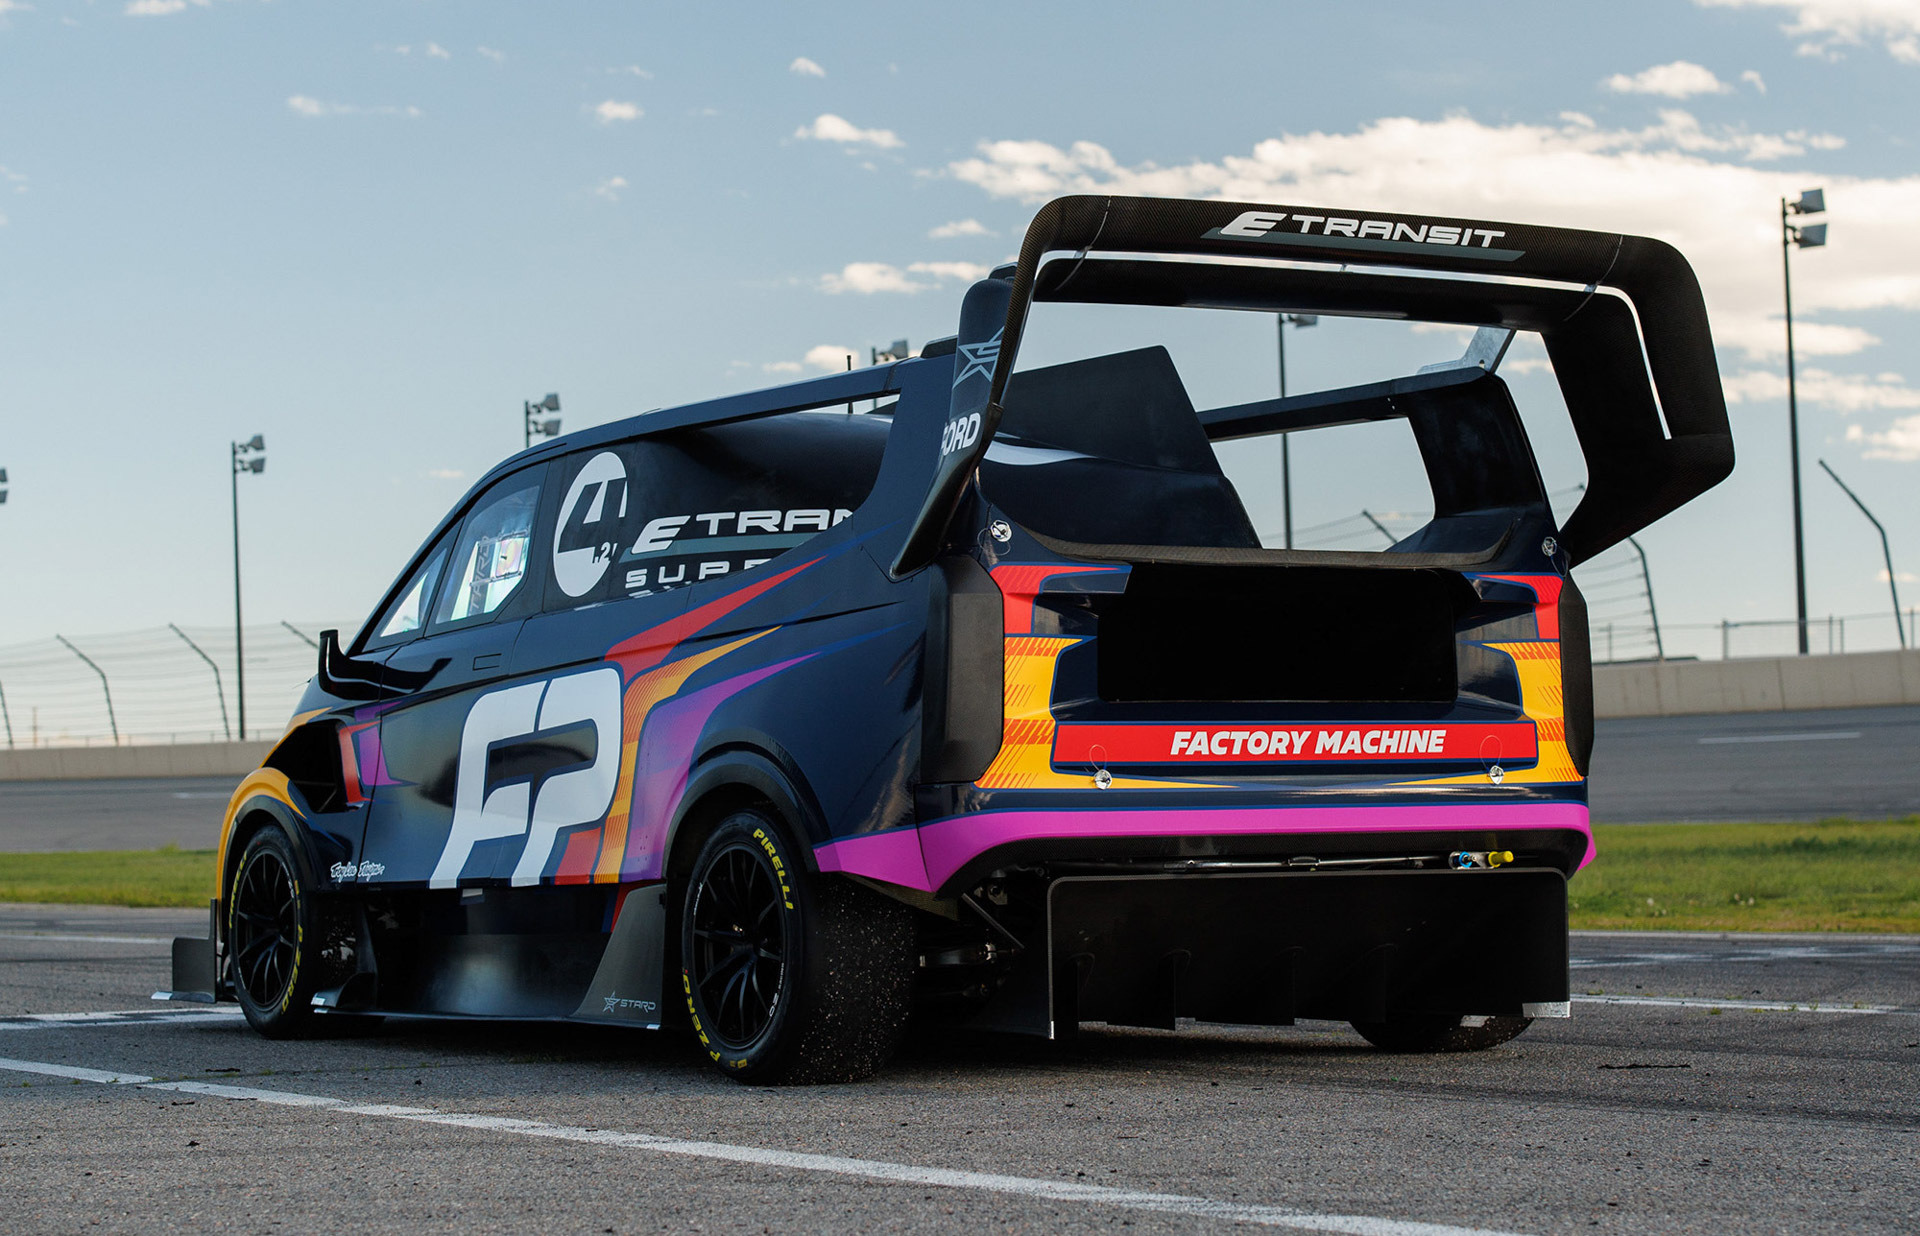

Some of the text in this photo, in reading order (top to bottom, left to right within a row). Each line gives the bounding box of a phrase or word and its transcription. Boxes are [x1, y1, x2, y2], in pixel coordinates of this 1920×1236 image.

[1169, 728, 1448, 756] FACTORY MACHINE
[753, 828, 795, 911] PIRELLI
[619, 998, 657, 1013] STARD
